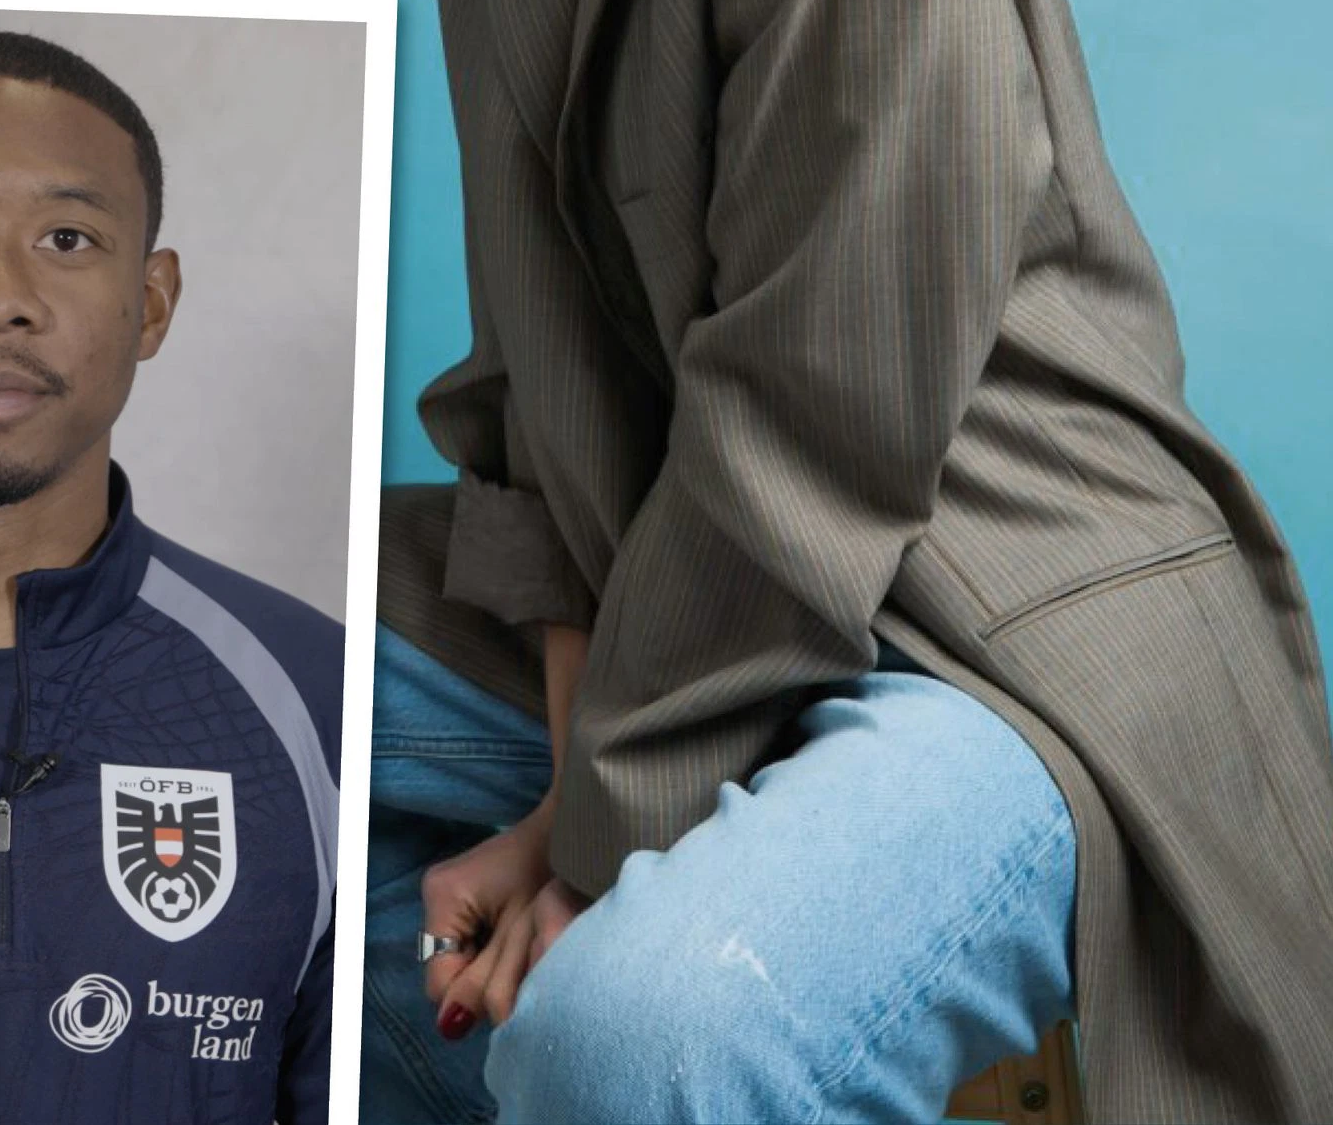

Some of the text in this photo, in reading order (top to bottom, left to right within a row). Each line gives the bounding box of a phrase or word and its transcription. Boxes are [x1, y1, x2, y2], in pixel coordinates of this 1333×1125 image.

[139, 777, 193, 795] ÖFB
[147, 980, 264, 1030] burgen
[191, 1024, 257, 1062] land
